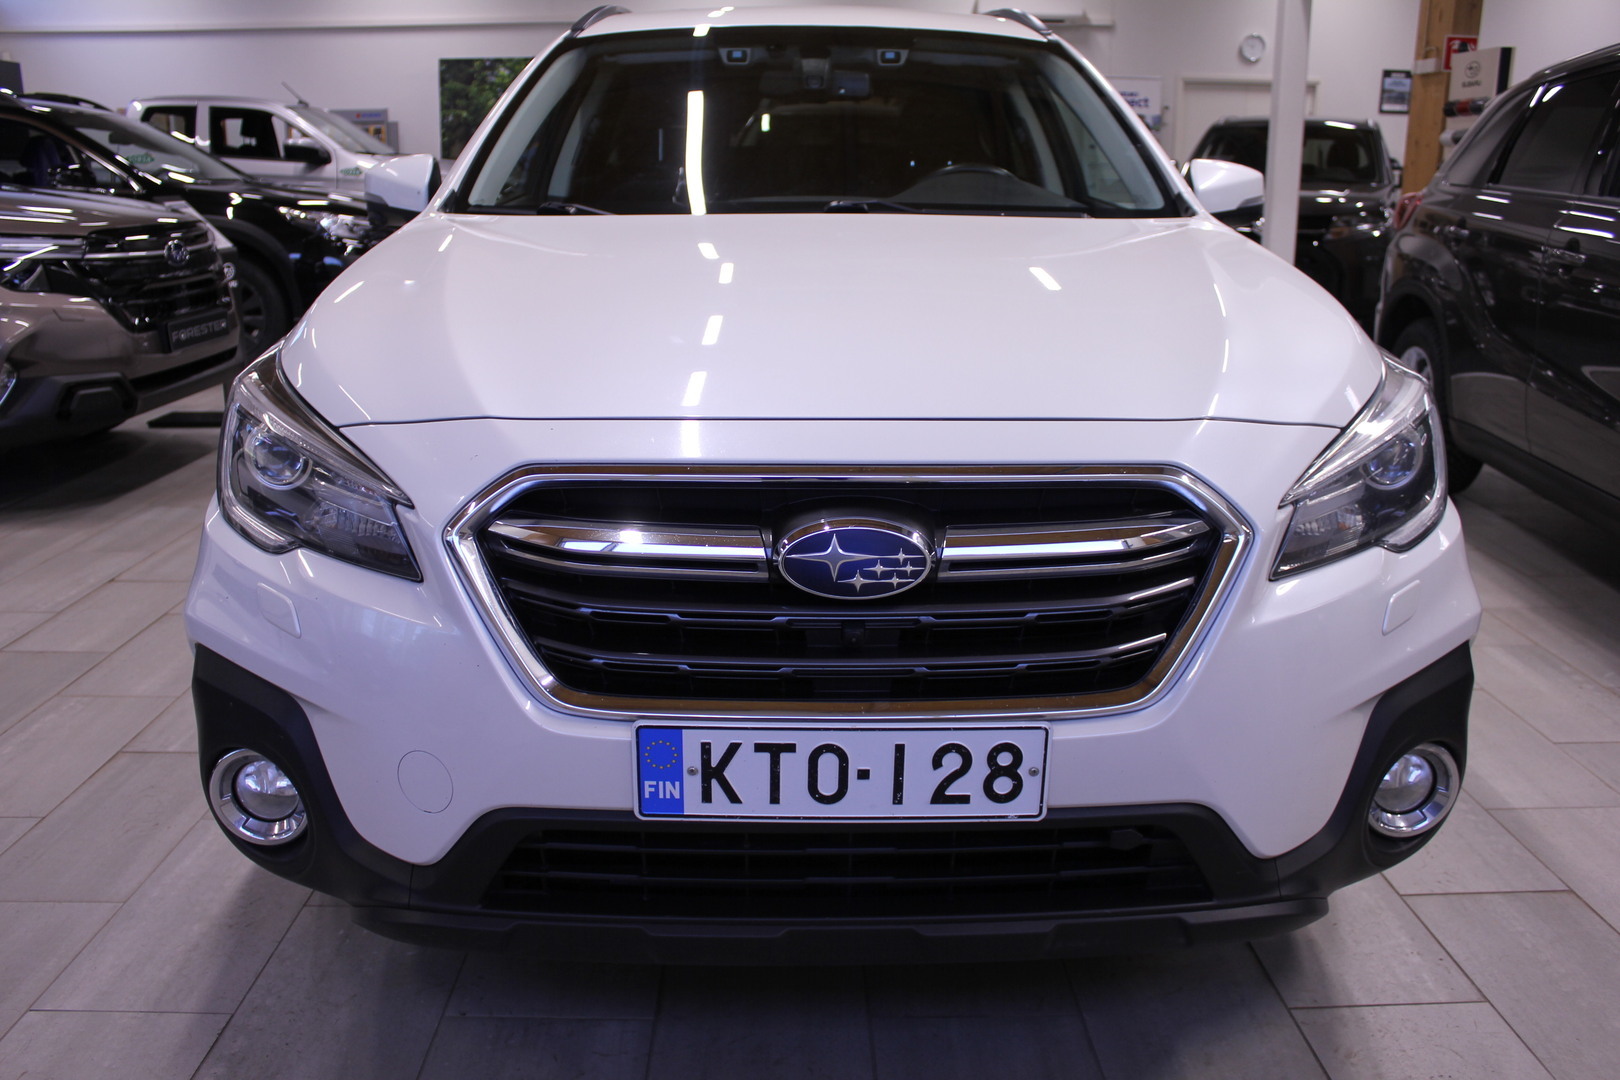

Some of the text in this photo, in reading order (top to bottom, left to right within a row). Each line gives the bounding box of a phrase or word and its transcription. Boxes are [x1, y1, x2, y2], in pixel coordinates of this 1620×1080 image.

[172, 319, 227, 342] FORESTER
[700, 741, 1024, 805] KTO-128
[643, 780, 681, 799] FIN
